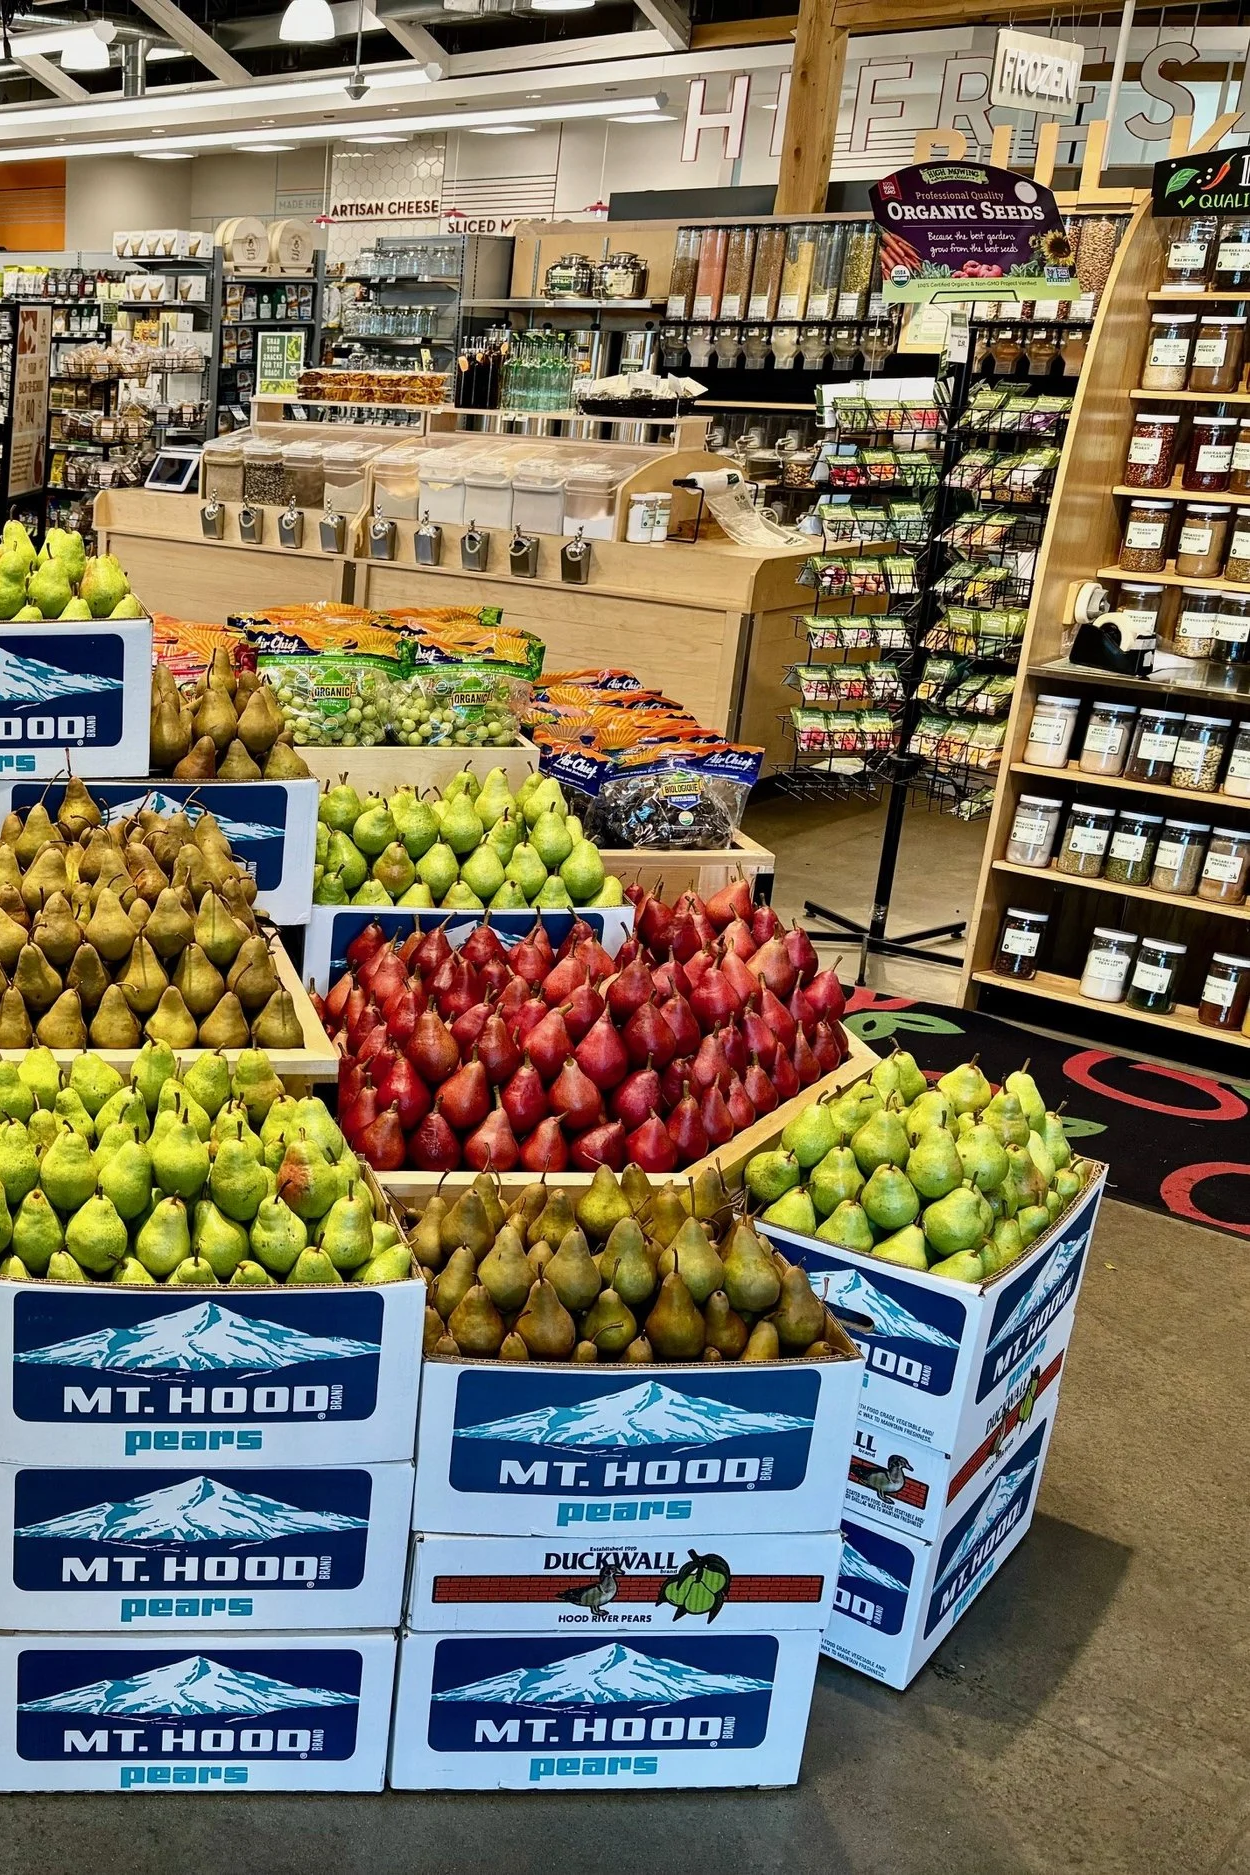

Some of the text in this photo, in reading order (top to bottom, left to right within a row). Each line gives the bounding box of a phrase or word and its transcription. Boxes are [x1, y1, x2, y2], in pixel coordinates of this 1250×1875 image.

[1001, 48, 1078, 104] FROZEN
[927, 168, 980, 179] HIGH MOWING
[279, 200, 304, 210] MADE
[916, 191, 1004, 201] Professional Quality
[1199, 193, 1250, 209] QUALI
[331, 200, 439, 217] ARTISAN CHEESE
[887, 201, 1045, 221] ORGANIC SEEDS
[447, 219, 496, 234] SLICED
[928, 232, 953, 241] Because
[955, 231, 968, 240] the
[987, 233, 1015, 245] gardens
[930, 244, 1018, 257] grow from the best seeds
[270, 636, 299, 654] Chief
[314, 687, 351, 697] ORGANIC
[454, 694, 488, 704] ORGANIC
[87, 716, 96, 738] BRAND
[557, 754, 597, 780] Air Chief
[706, 753, 755, 771] Air Chief
[664, 783, 698, 794] BIOLOGIQUE
[993, 1290, 1069, 1382] MT. HOOD
[921, 1364, 931, 1386] BRAND
[1006, 1335, 1047, 1396] pears
[63, 1384, 342, 1413] MT. HOOD BRAND
[881, 1418, 903, 1432] MAINTAIN
[896, 1415, 921, 1432] VEGETABLE
[125, 1431, 262, 1456] pears
[500, 1456, 774, 1487] MT. HOOD BRAND
[557, 1500, 692, 1526] pears
[62, 1556, 331, 1582] MT. HOOD BRAND
[544, 1552, 678, 1570] DUCKWALL
[939, 1564, 969, 1615] MT.
[971, 1509, 1016, 1575] HOOD
[952, 1557, 994, 1624] pears
[121, 1598, 253, 1622] pears
[558, 1614, 651, 1623] HOOD RIVER PEARS
[475, 1716, 735, 1742] MT. HOOD BRAND
[64, 1729, 324, 1752] MT. HOOD BRAND
[120, 1766, 248, 1788] pears
[530, 1756, 658, 1780] pears
